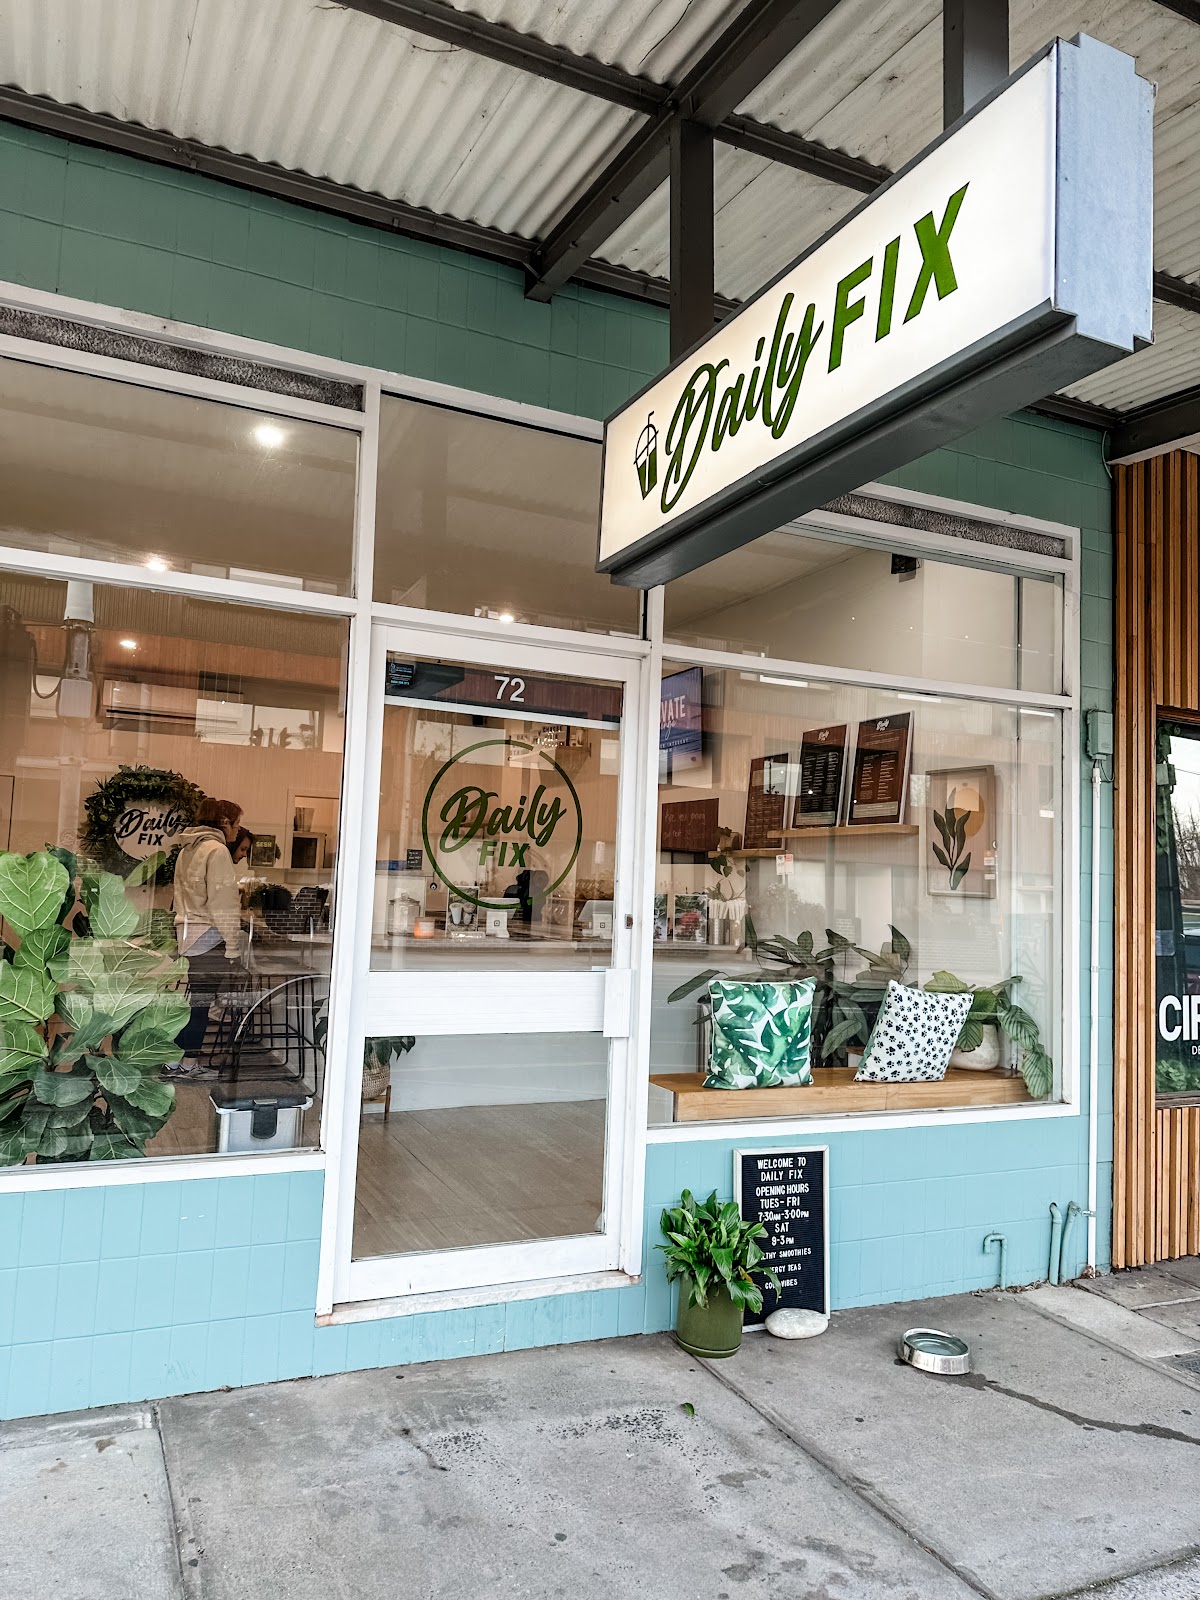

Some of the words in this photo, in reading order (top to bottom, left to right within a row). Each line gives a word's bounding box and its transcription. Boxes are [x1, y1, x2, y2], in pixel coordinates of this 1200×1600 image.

[661, 292, 824, 514] Daily
[827, 181, 970, 374] FIX
[494, 675, 525, 702] 72
[660, 695, 686, 722] VATE
[116, 808, 182, 837] Daily
[440, 784, 567, 853] Daily
[138, 833, 165, 846] FIX
[479, 841, 530, 868] FIX
[757, 1158, 793, 1169] WELCOME
[797, 1157, 806, 1166] TO
[761, 1171, 783, 1181] DAILY
[789, 1169, 803, 1179] FIX
[756, 1185, 785, 1197] OPENING
[786, 1183, 809, 1194] HOURS
[774, 1222, 789, 1233] SAT
[760, 1252, 776, 1260] LTHY
[779, 1248, 811, 1258] SMOOTHIES
[764, 1265, 785, 1275] ERGY
[787, 1263, 801, 1272] TEAS
[781, 1278, 798, 1288] VIBES
